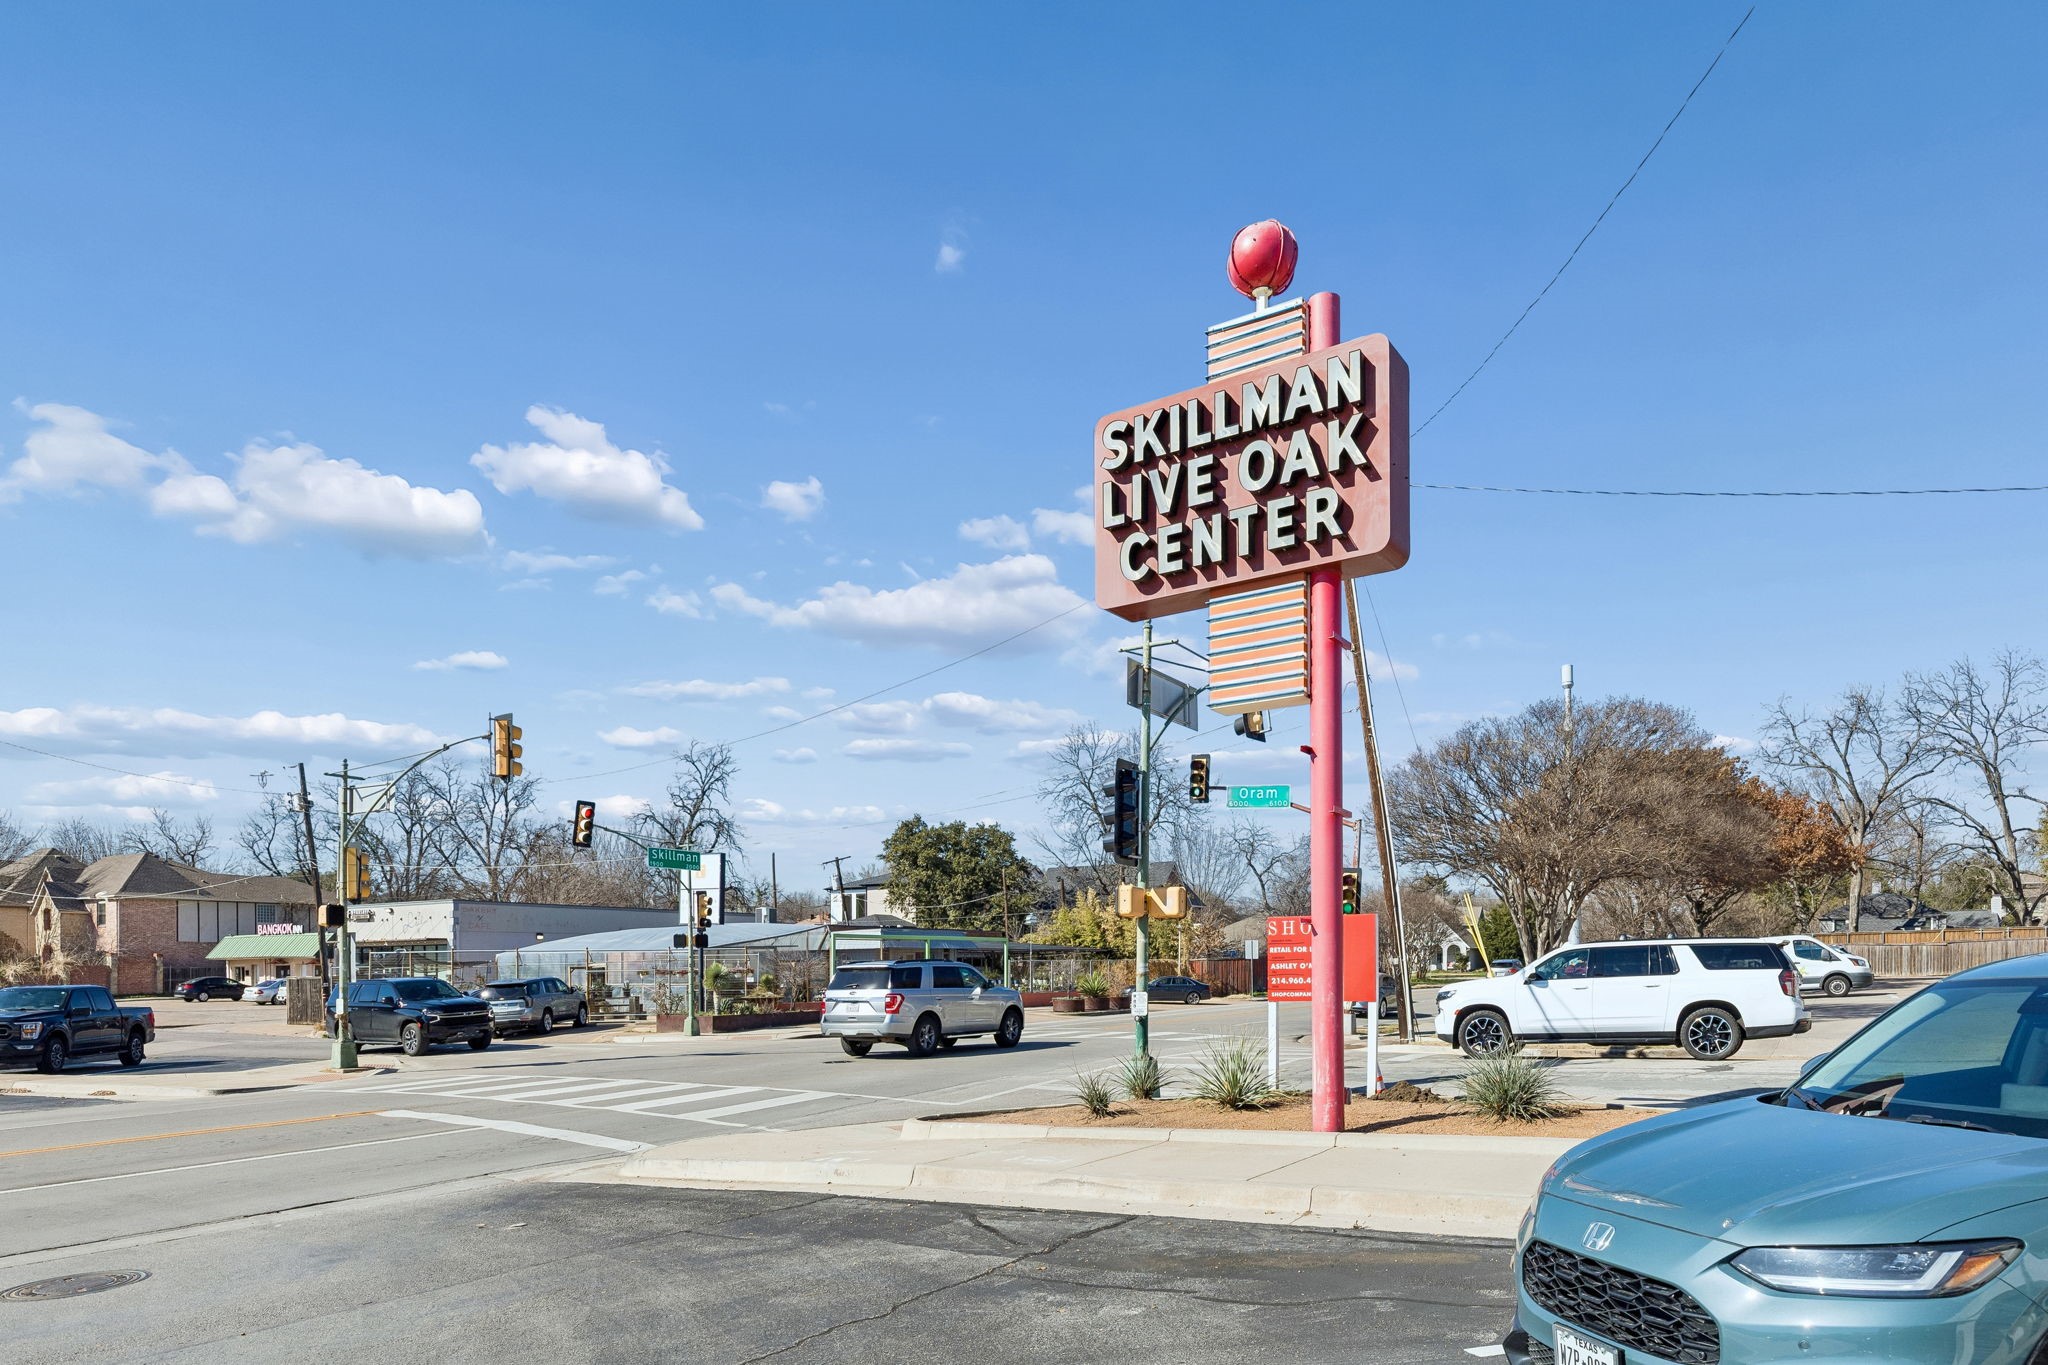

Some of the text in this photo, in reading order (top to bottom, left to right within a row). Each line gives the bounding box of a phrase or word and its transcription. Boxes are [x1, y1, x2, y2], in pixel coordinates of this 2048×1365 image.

[1100, 349, 1364, 472] SKILLMAN
[1102, 412, 1368, 530] LIVE OAK
[1119, 486, 1345, 583] CENTER
[1239, 787, 1278, 799] Oram
[652, 849, 698, 862] Skillman
[257, 923, 303, 935] BANGKOK INN
[1574, 1336, 1598, 1354] TEXAS
